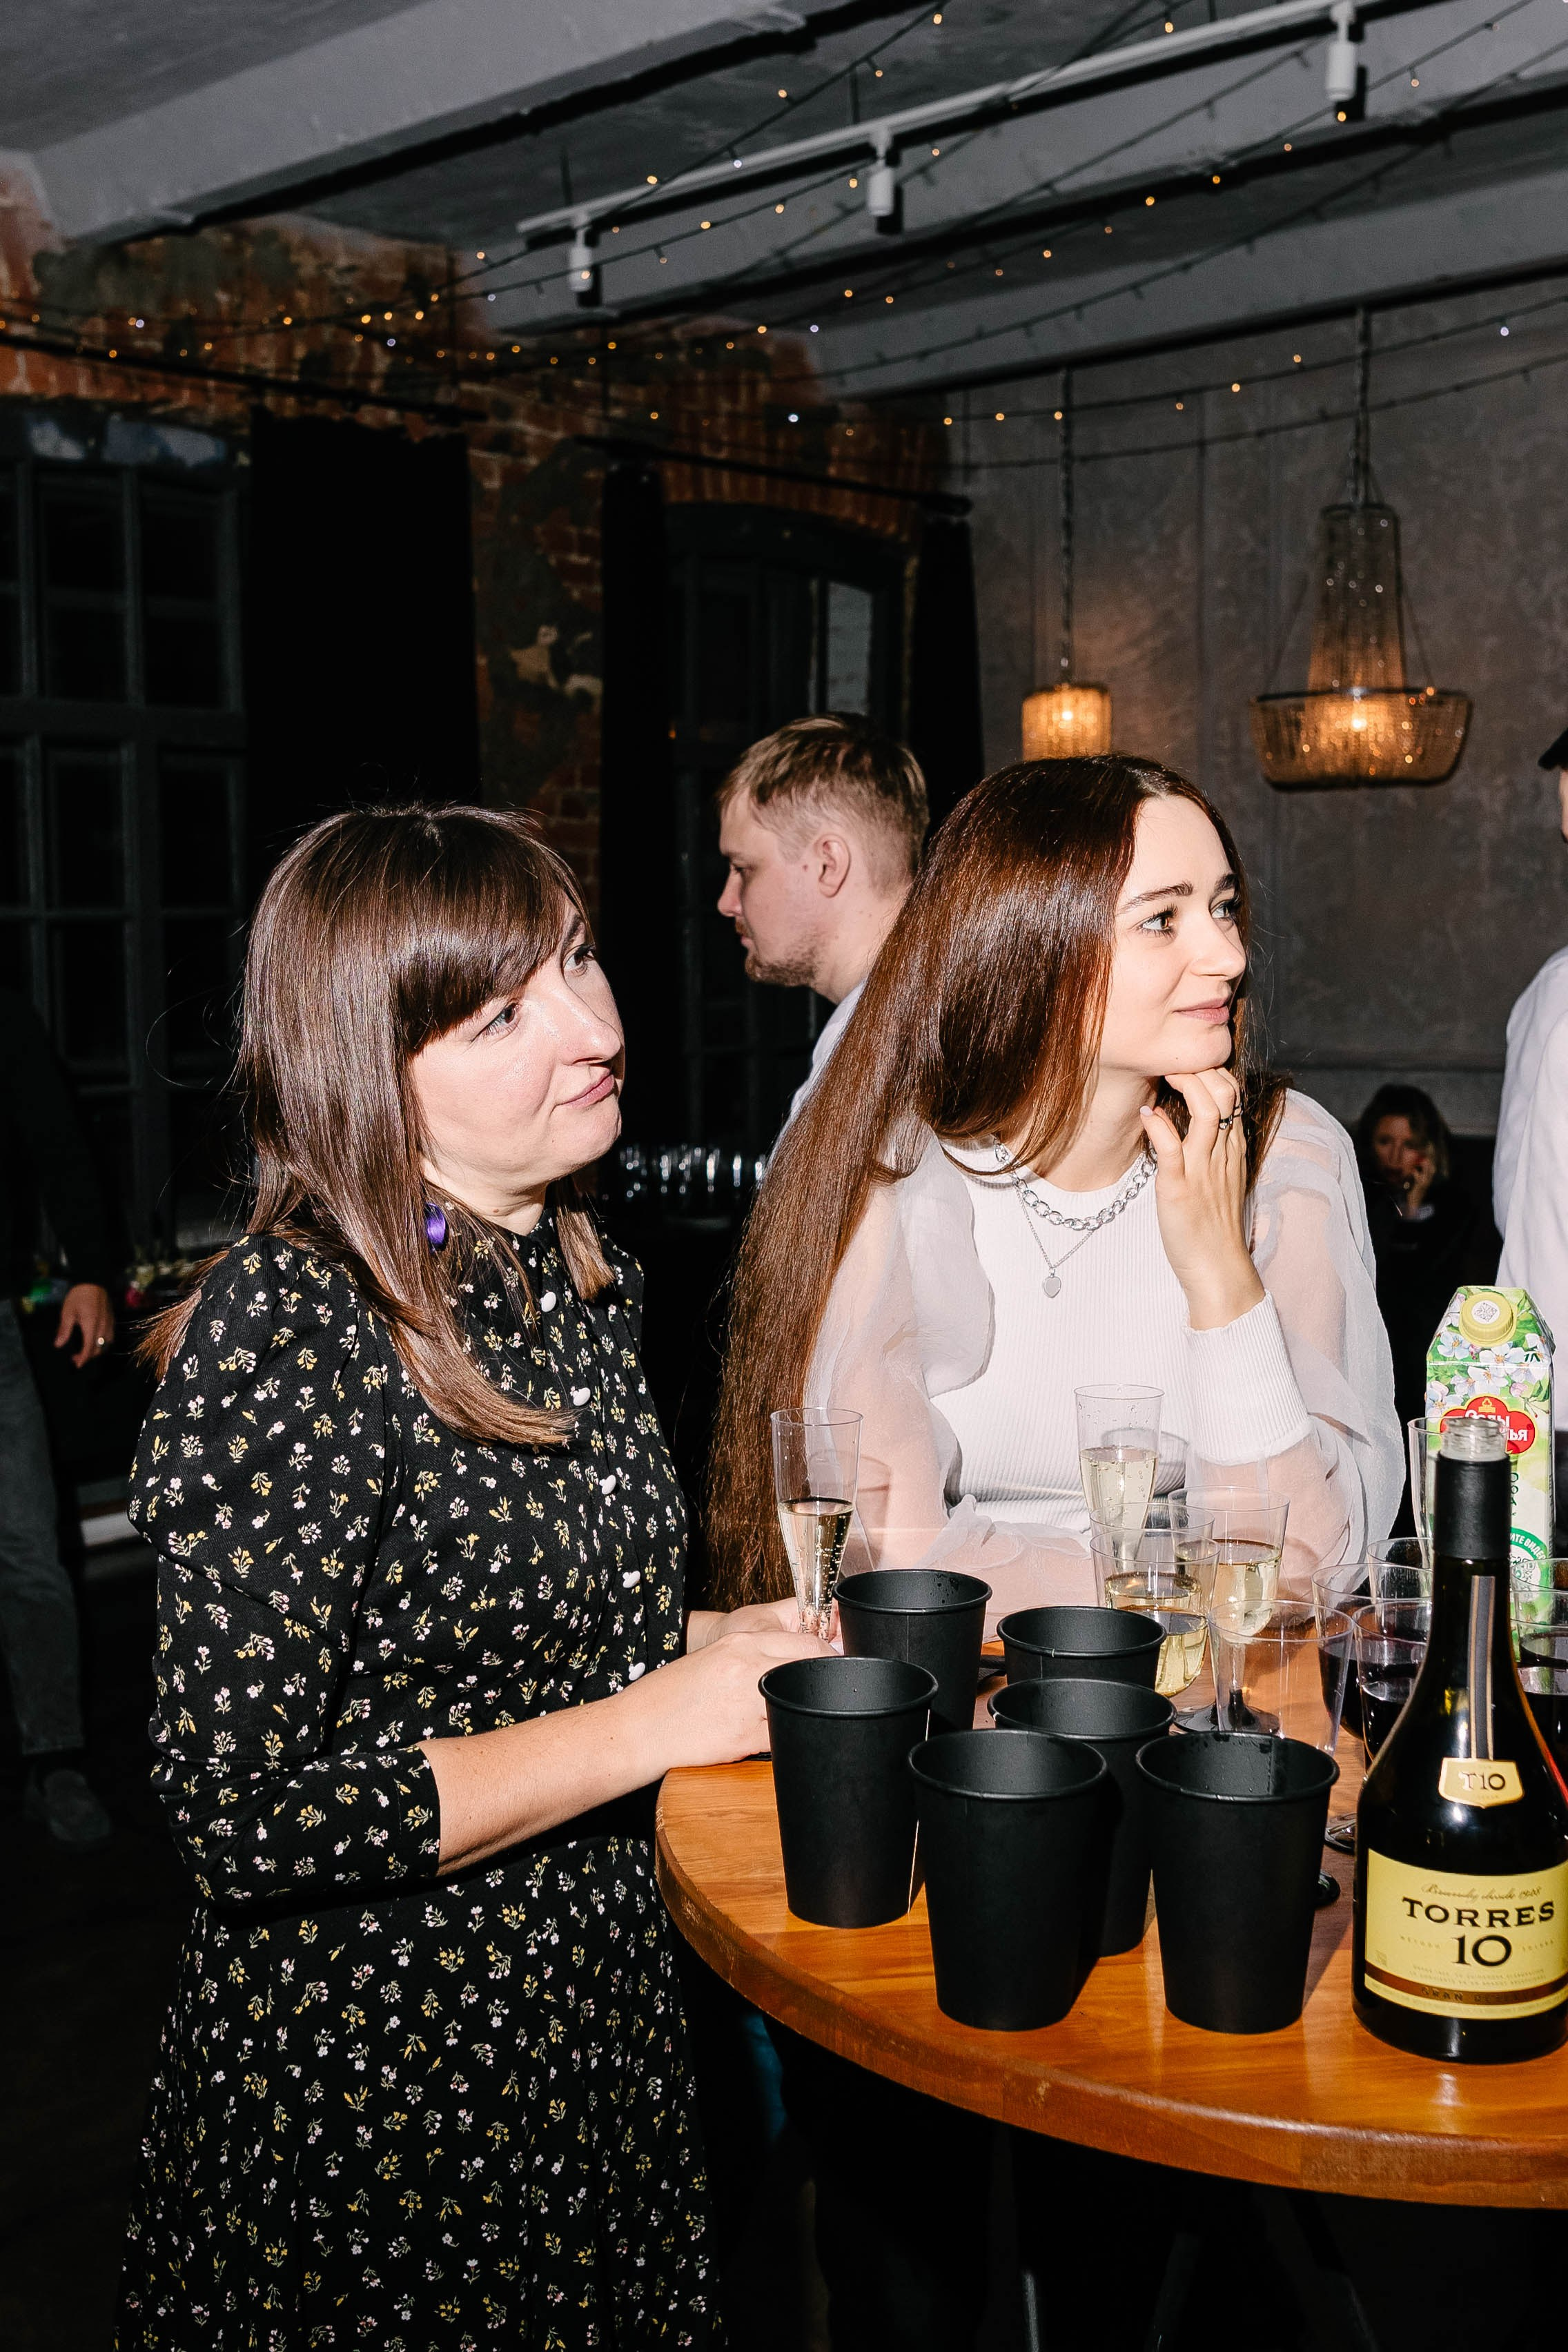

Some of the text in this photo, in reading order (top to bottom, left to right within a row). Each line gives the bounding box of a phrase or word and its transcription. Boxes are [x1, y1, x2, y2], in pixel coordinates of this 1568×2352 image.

[1458, 1770, 1506, 1791] T10
[1402, 1896, 1555, 1928] TORRES
[1451, 1934, 1513, 1967] 10
